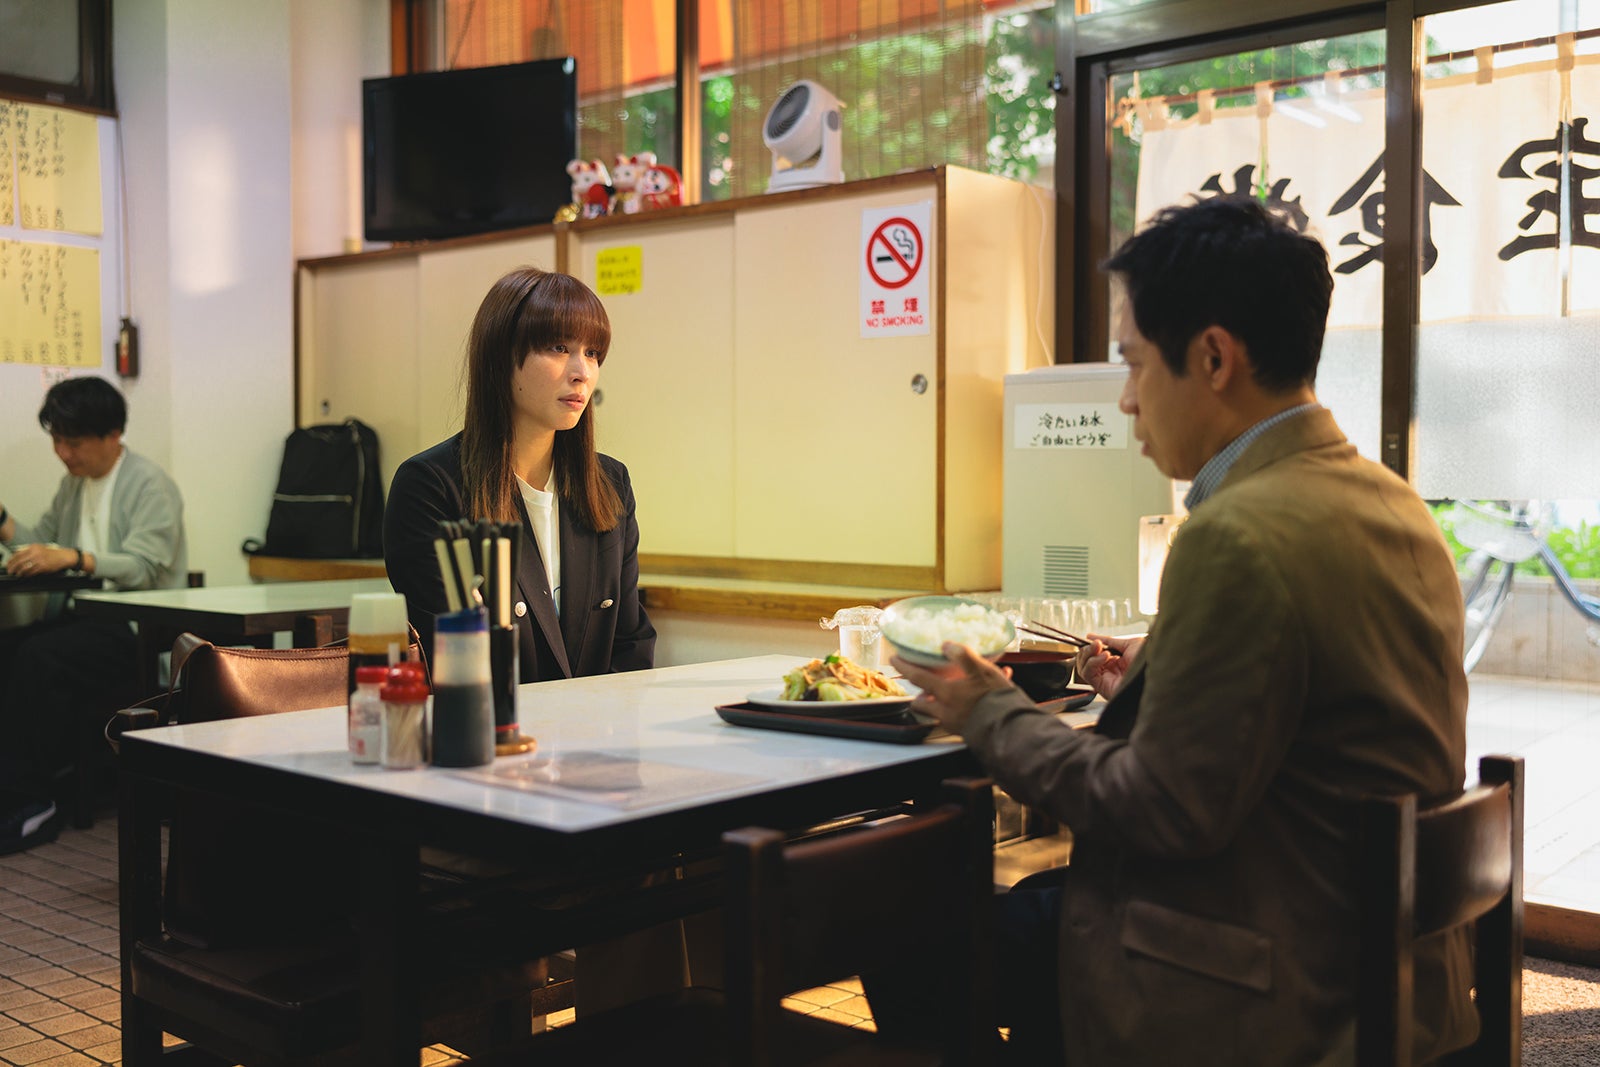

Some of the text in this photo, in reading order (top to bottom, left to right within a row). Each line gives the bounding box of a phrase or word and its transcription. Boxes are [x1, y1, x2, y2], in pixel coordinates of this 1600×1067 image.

[866, 315, 924, 328] NO SMOKING
[1038, 410, 1103, 430] 冷たいお水
[1029, 432, 1112, 447] ご自由にどうぞ
